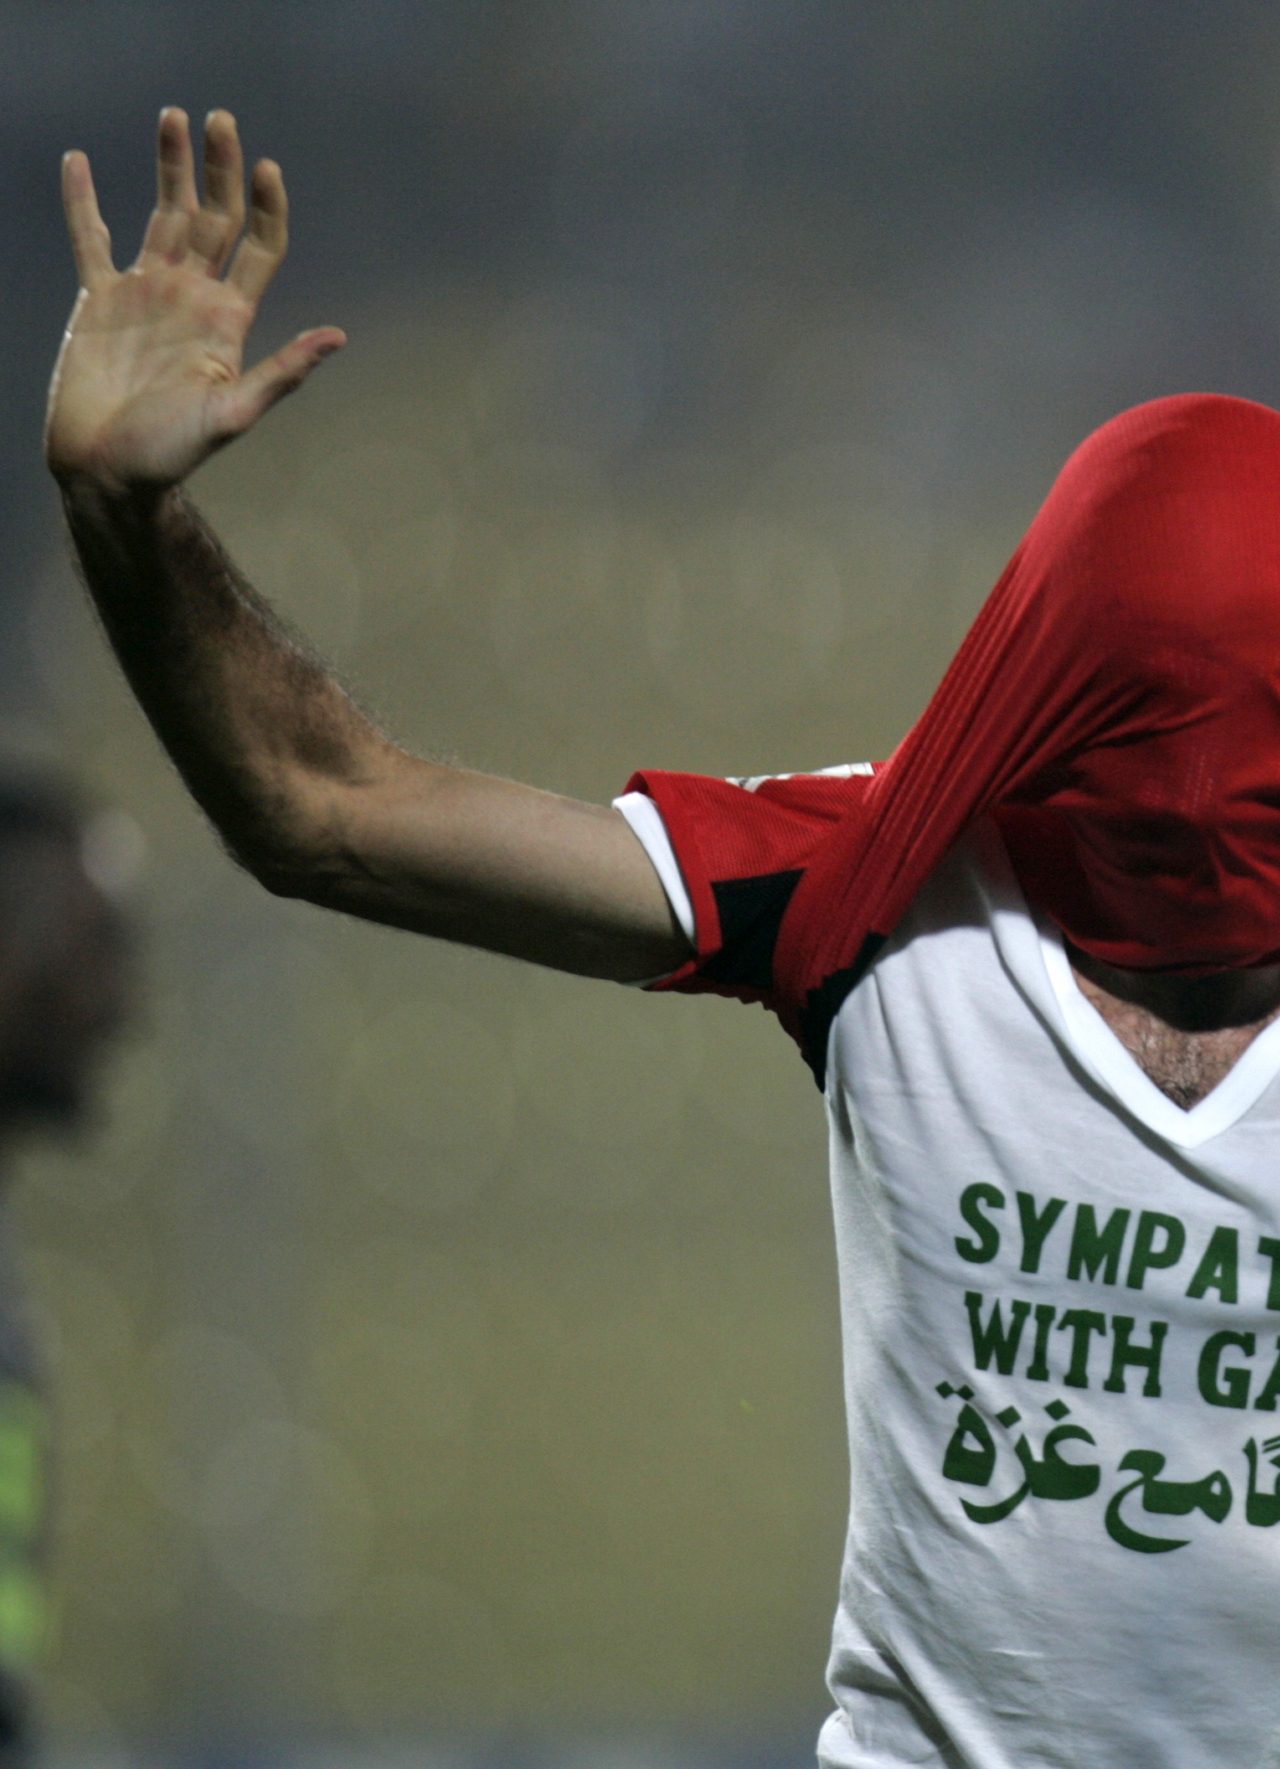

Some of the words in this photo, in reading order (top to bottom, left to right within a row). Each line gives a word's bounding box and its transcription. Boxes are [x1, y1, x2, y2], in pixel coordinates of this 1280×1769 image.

[965, 1291, 1168, 1398] WITH
[935, 1380, 1101, 1525] غزة
[1105, 1448, 1233, 1554] مع
